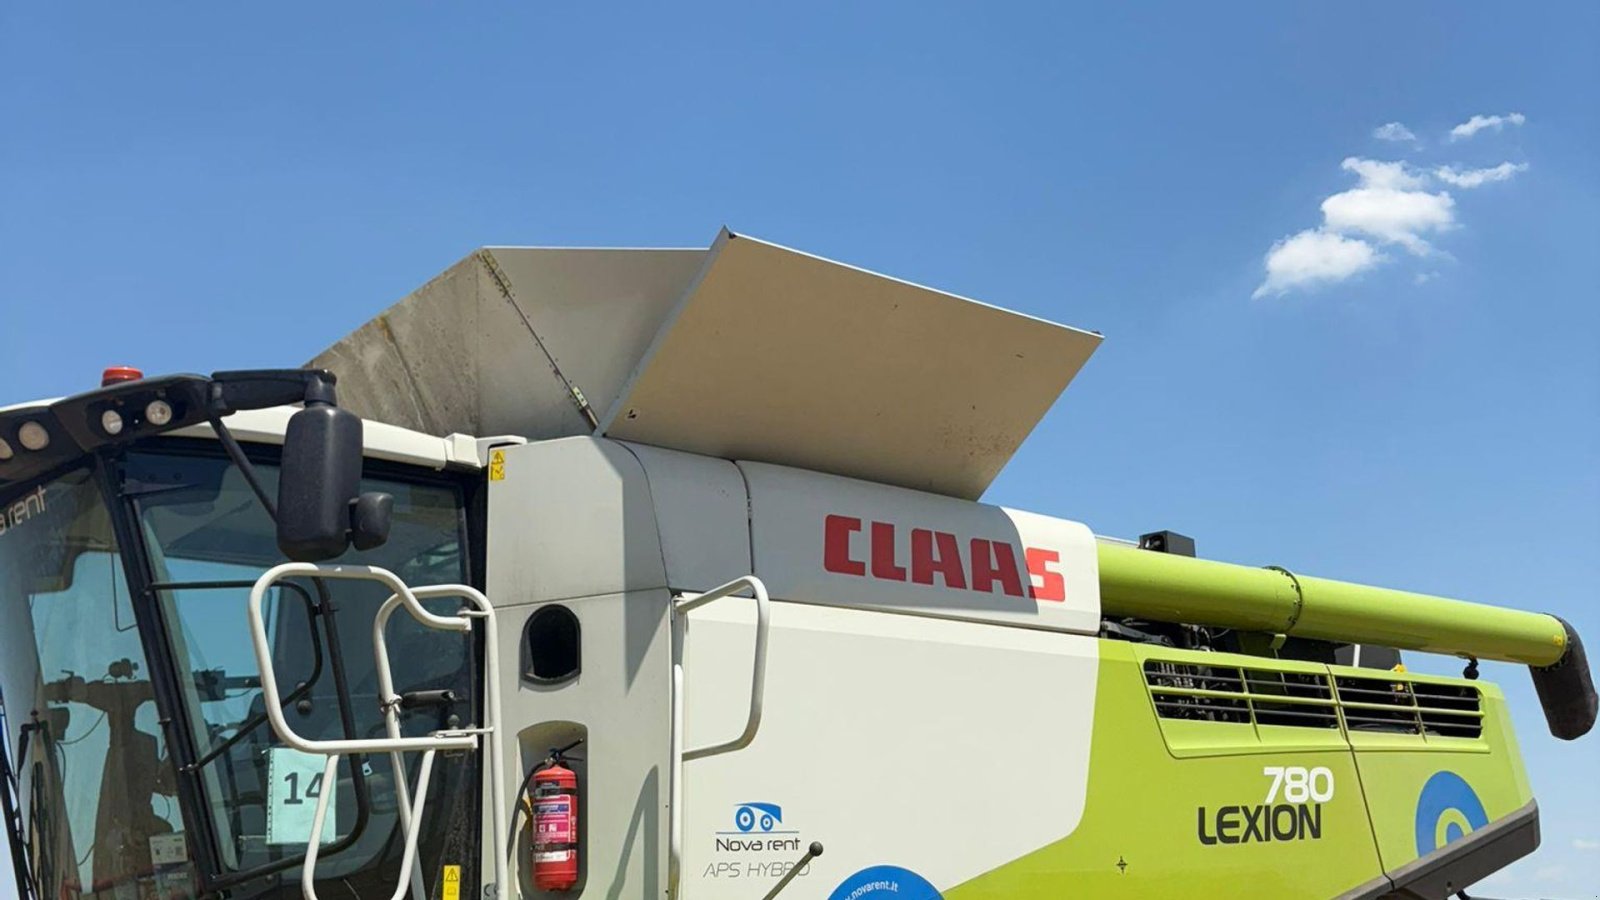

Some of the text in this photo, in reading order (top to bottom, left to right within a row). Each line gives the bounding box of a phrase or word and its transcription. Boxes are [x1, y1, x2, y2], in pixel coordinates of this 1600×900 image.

[8, 485, 47, 529] rent
[824, 513, 1066, 603] CLAAS
[284, 771, 325, 805] 14
[1263, 766, 1335, 804] 780
[1198, 803, 1321, 845] LEXION
[716, 837, 801, 852] Nova rent
[703, 861, 811, 878] APS HYBRD
